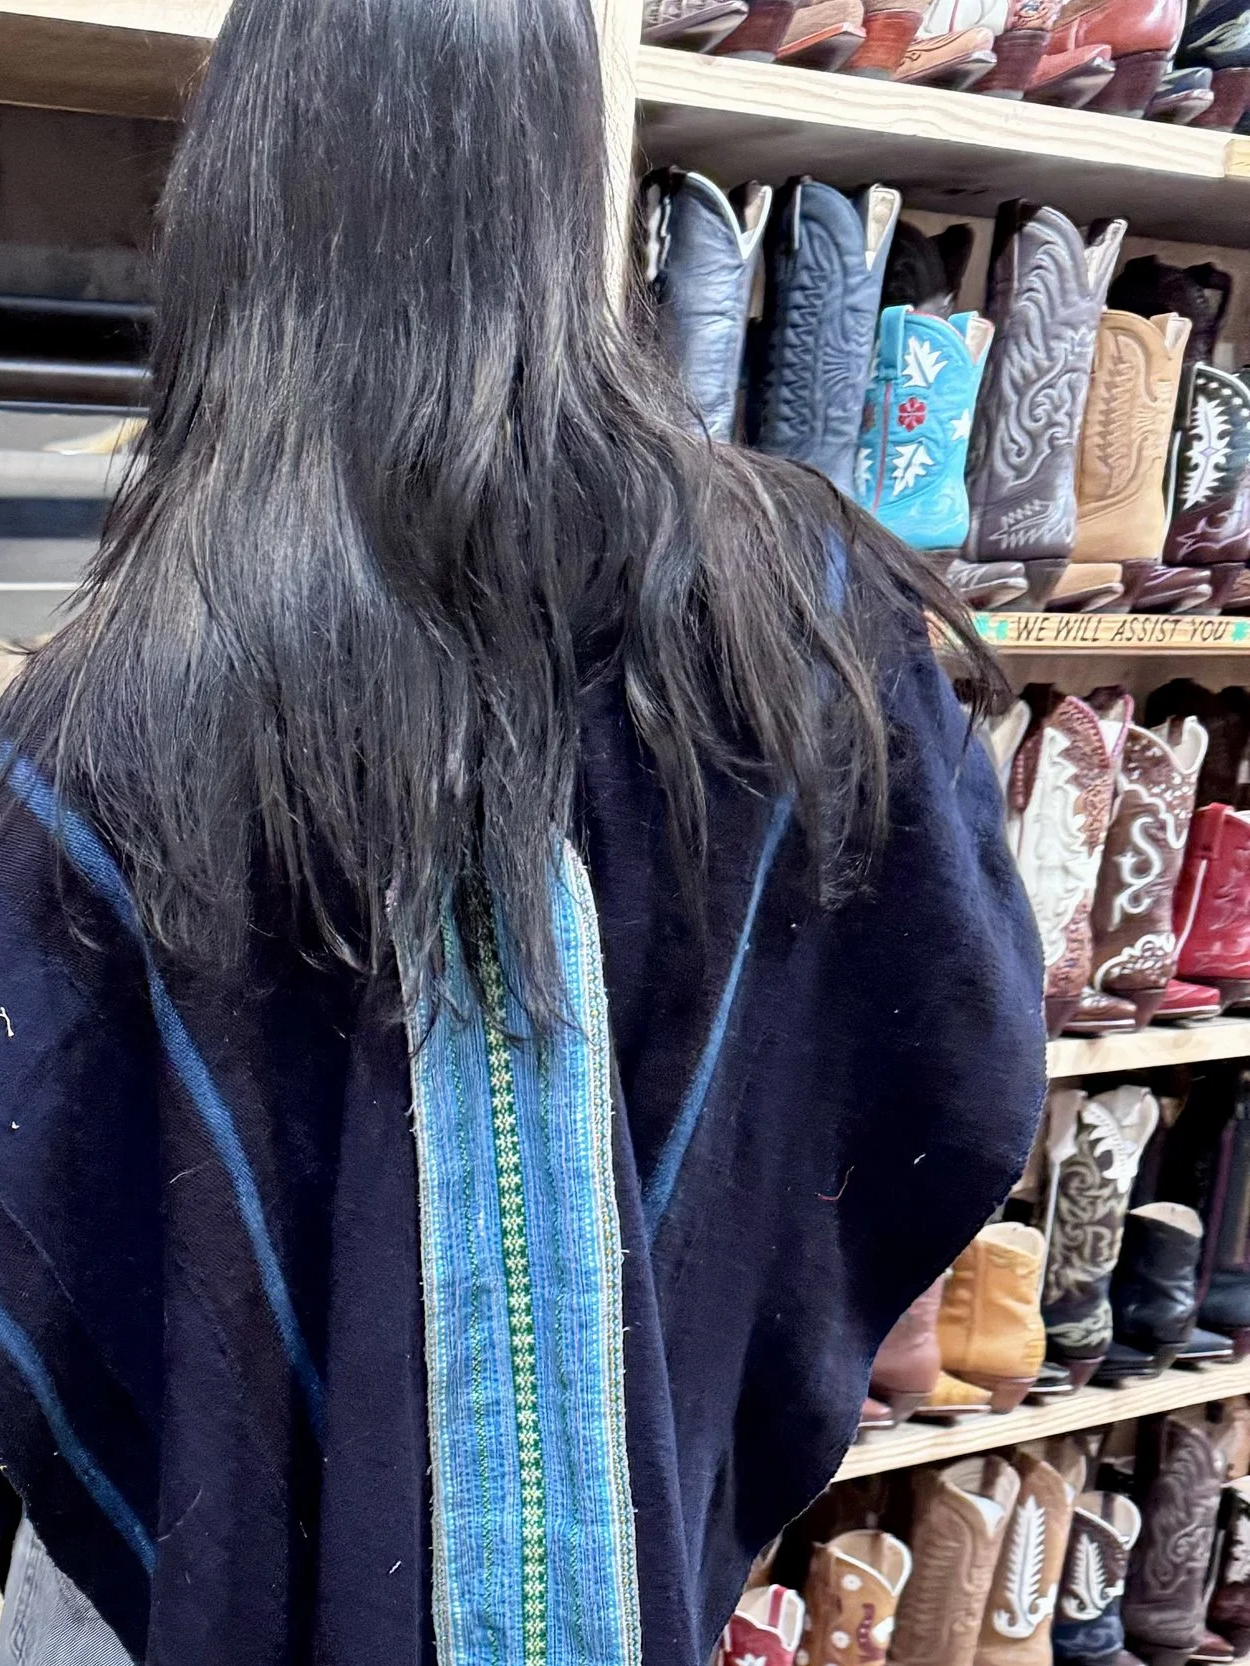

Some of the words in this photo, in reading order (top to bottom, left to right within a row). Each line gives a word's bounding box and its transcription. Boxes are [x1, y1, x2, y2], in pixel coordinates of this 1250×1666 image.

[1016, 616, 1050, 642] WE
[1054, 616, 1103, 642] WILL
[1110, 617, 1182, 642] ASSIST
[1189, 617, 1230, 642] YOU
